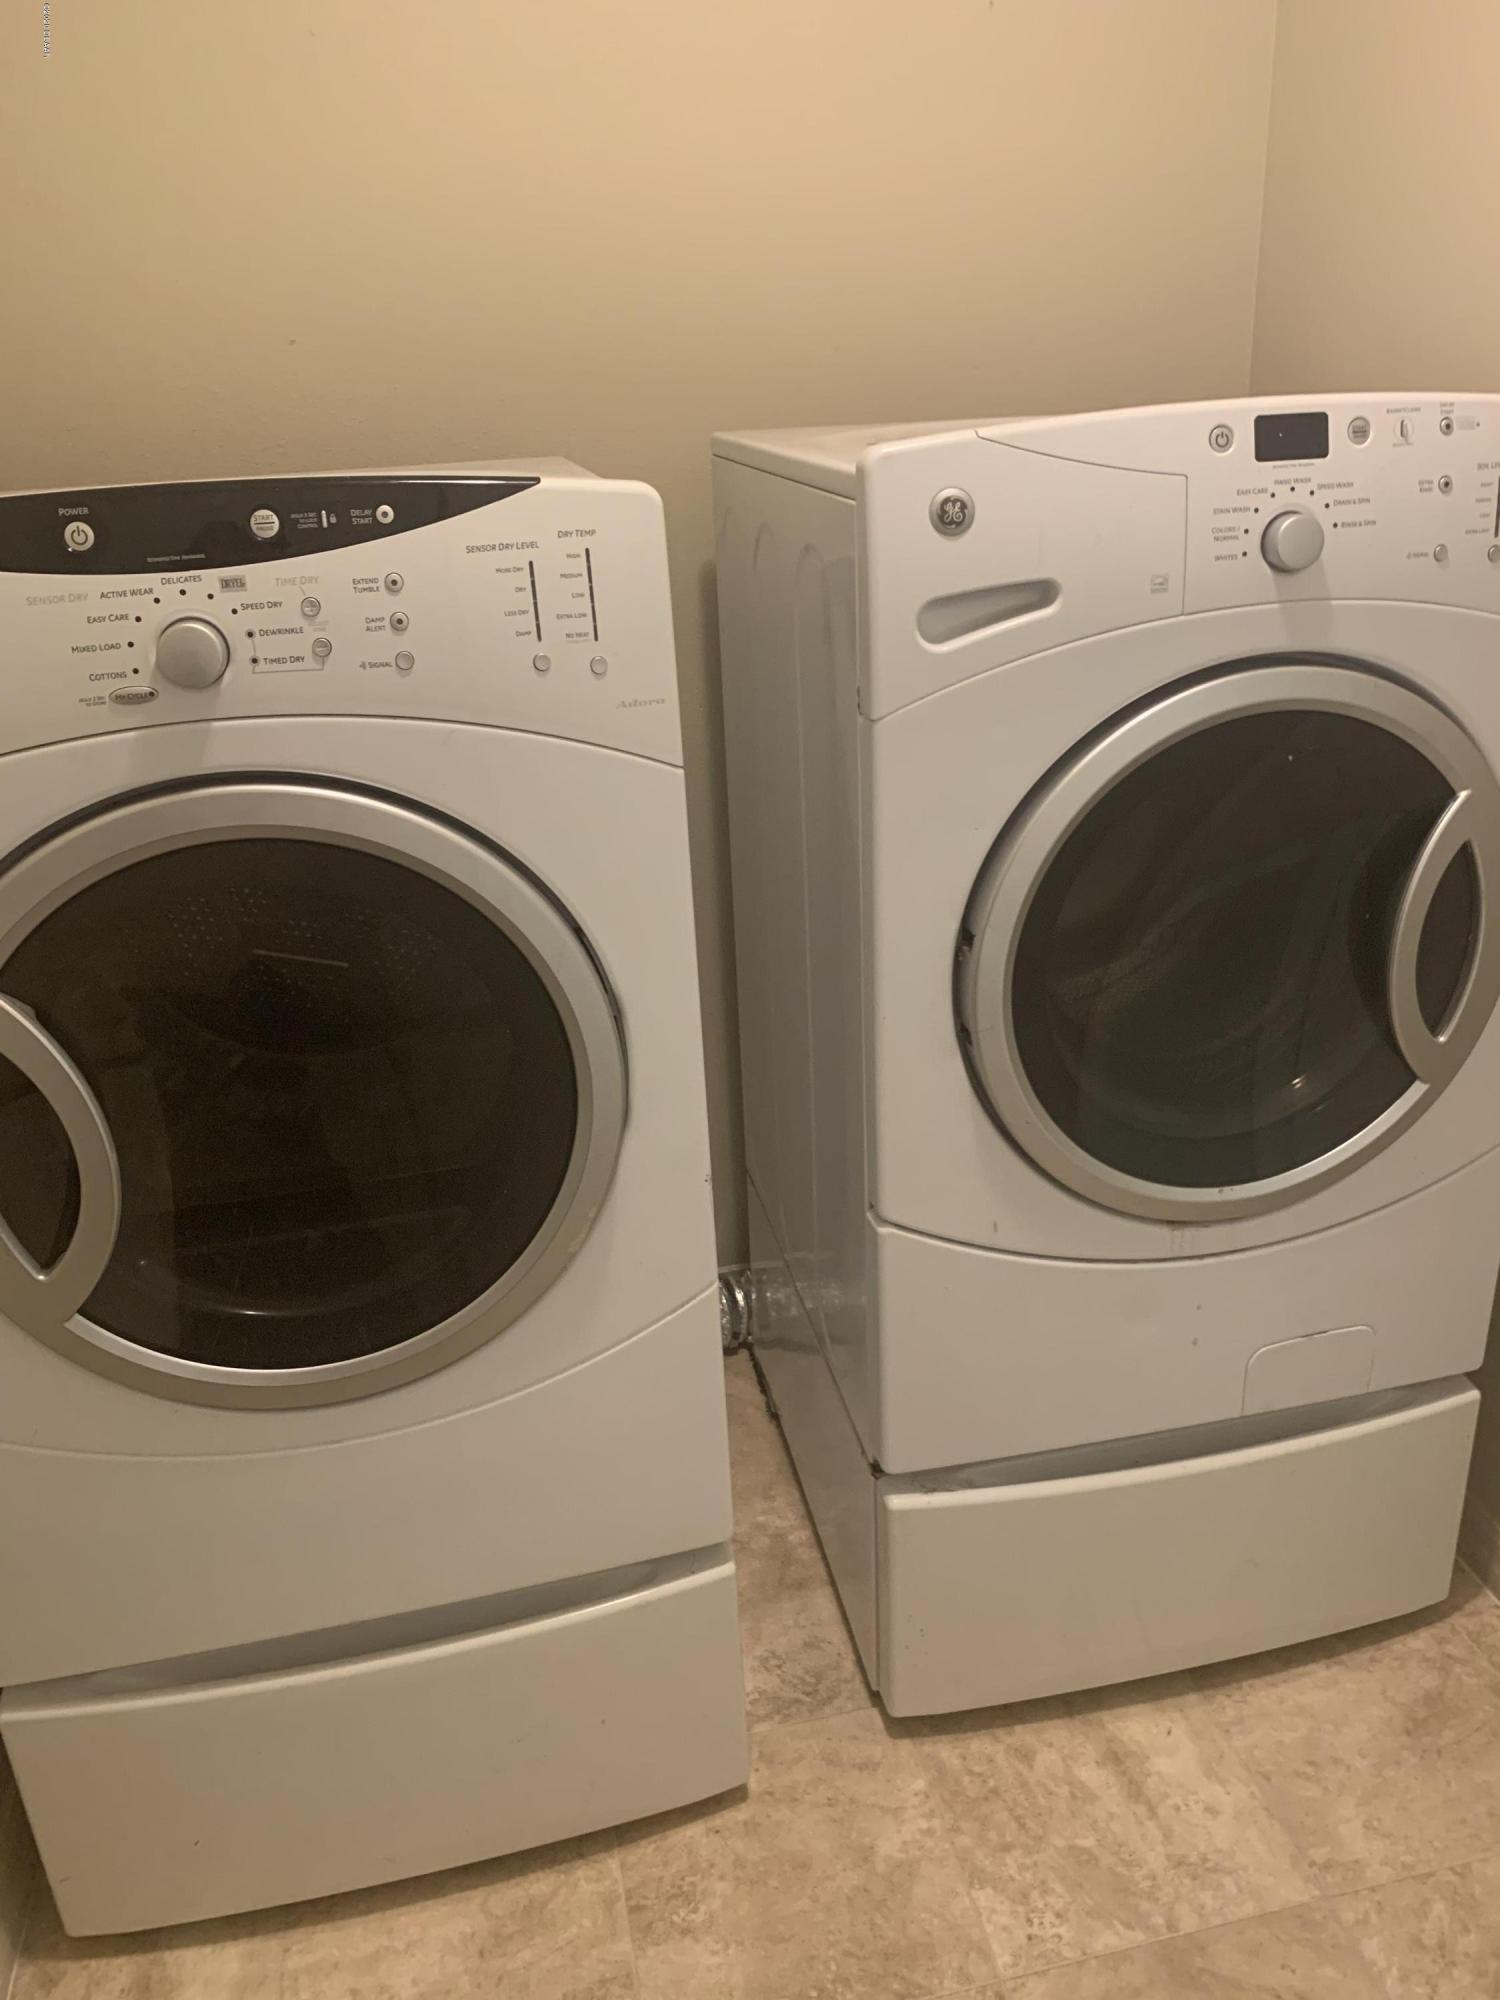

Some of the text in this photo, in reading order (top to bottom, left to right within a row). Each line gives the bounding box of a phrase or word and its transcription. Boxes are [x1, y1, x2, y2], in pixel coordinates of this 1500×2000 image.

[1252, 487, 1268, 495] CARE
[58, 507, 89, 517] POWER
[1231, 506, 1250, 514] WASH
[254, 513, 274, 522] START
[351, 517, 373, 525] START
[557, 528, 597, 538] DRY TEMP
[465, 541, 540, 554] SENSOR DRY LEVEL
[160, 575, 203, 585] DELICATES
[275, 575, 319, 587] TIME DRY
[352, 577, 379, 585] EXTEND
[100, 588, 154, 600] ACTIVE WEAR
[353, 586, 380, 594] TUMBLE
[26, 592, 89, 606] SENSOR DRY
[240, 601, 283, 611] SPEED DRY
[87, 613, 129, 624] EASY CARE
[365, 616, 385, 624] DAMP
[259, 626, 304, 637] DEWRINKLE
[71, 642, 121, 654] MIXED LOAD
[263, 655, 305, 665] TIMED DRY
[89, 671, 128, 682] COTTONS
[616, 698, 666, 710] Adora
